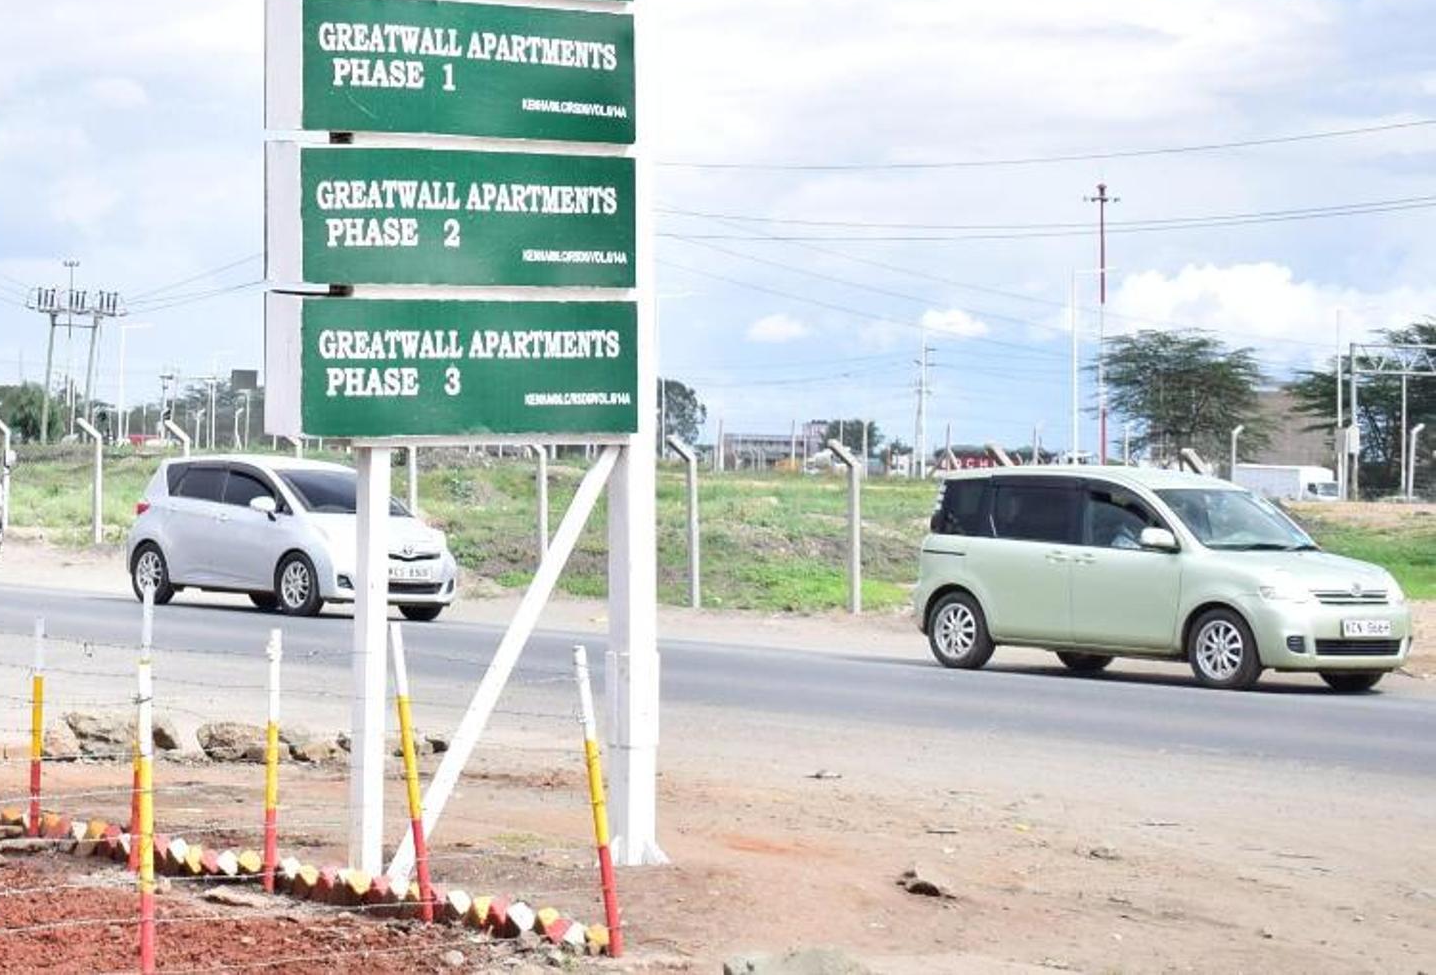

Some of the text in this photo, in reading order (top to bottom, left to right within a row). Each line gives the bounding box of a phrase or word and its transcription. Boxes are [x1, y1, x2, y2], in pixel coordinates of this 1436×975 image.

[319, 22, 618, 70] GREATWALL APARTMENTS
[332, 57, 456, 91] PHASE 1
[316, 180, 618, 214] GREATWALL APARTMENTS
[326, 217, 460, 247] PHASE 2
[319, 329, 621, 358] GREATWALL APARTMENTS
[326, 367, 461, 396] PHASE 3
